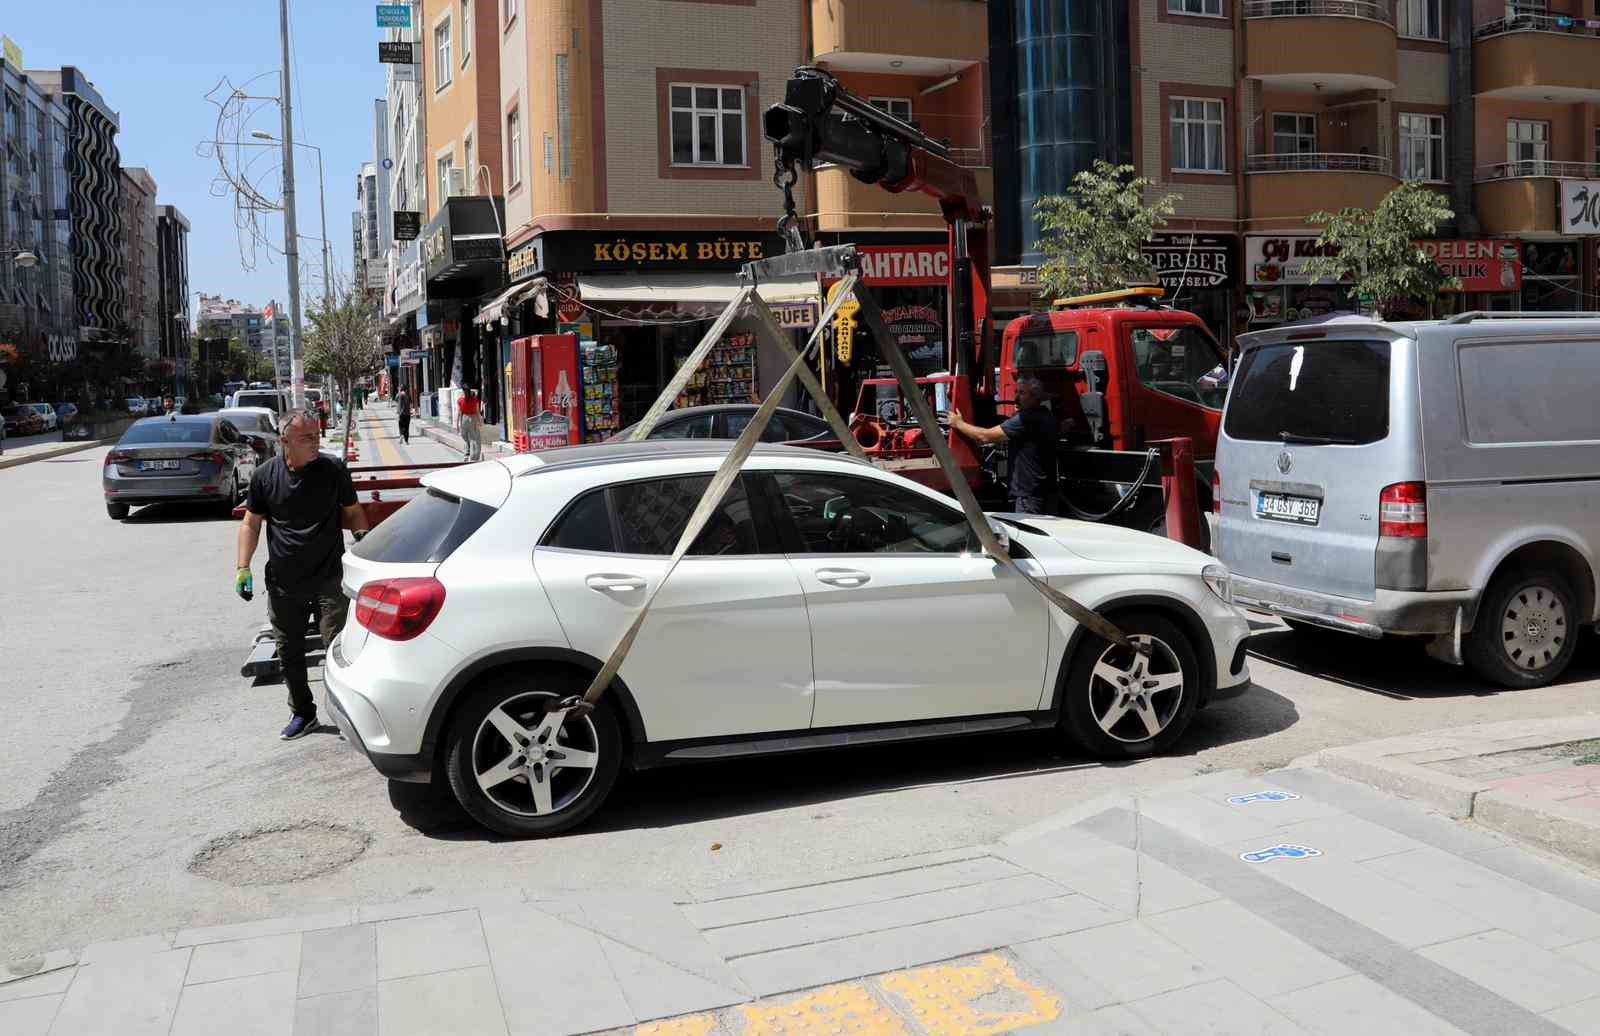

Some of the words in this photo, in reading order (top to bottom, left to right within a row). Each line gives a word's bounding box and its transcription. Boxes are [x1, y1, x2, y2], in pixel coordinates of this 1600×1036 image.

[594, 238, 688, 264] KÖŞEM
[697, 237, 763, 260] BÜFE
[1161, 276, 1209, 287] VEYSEL
